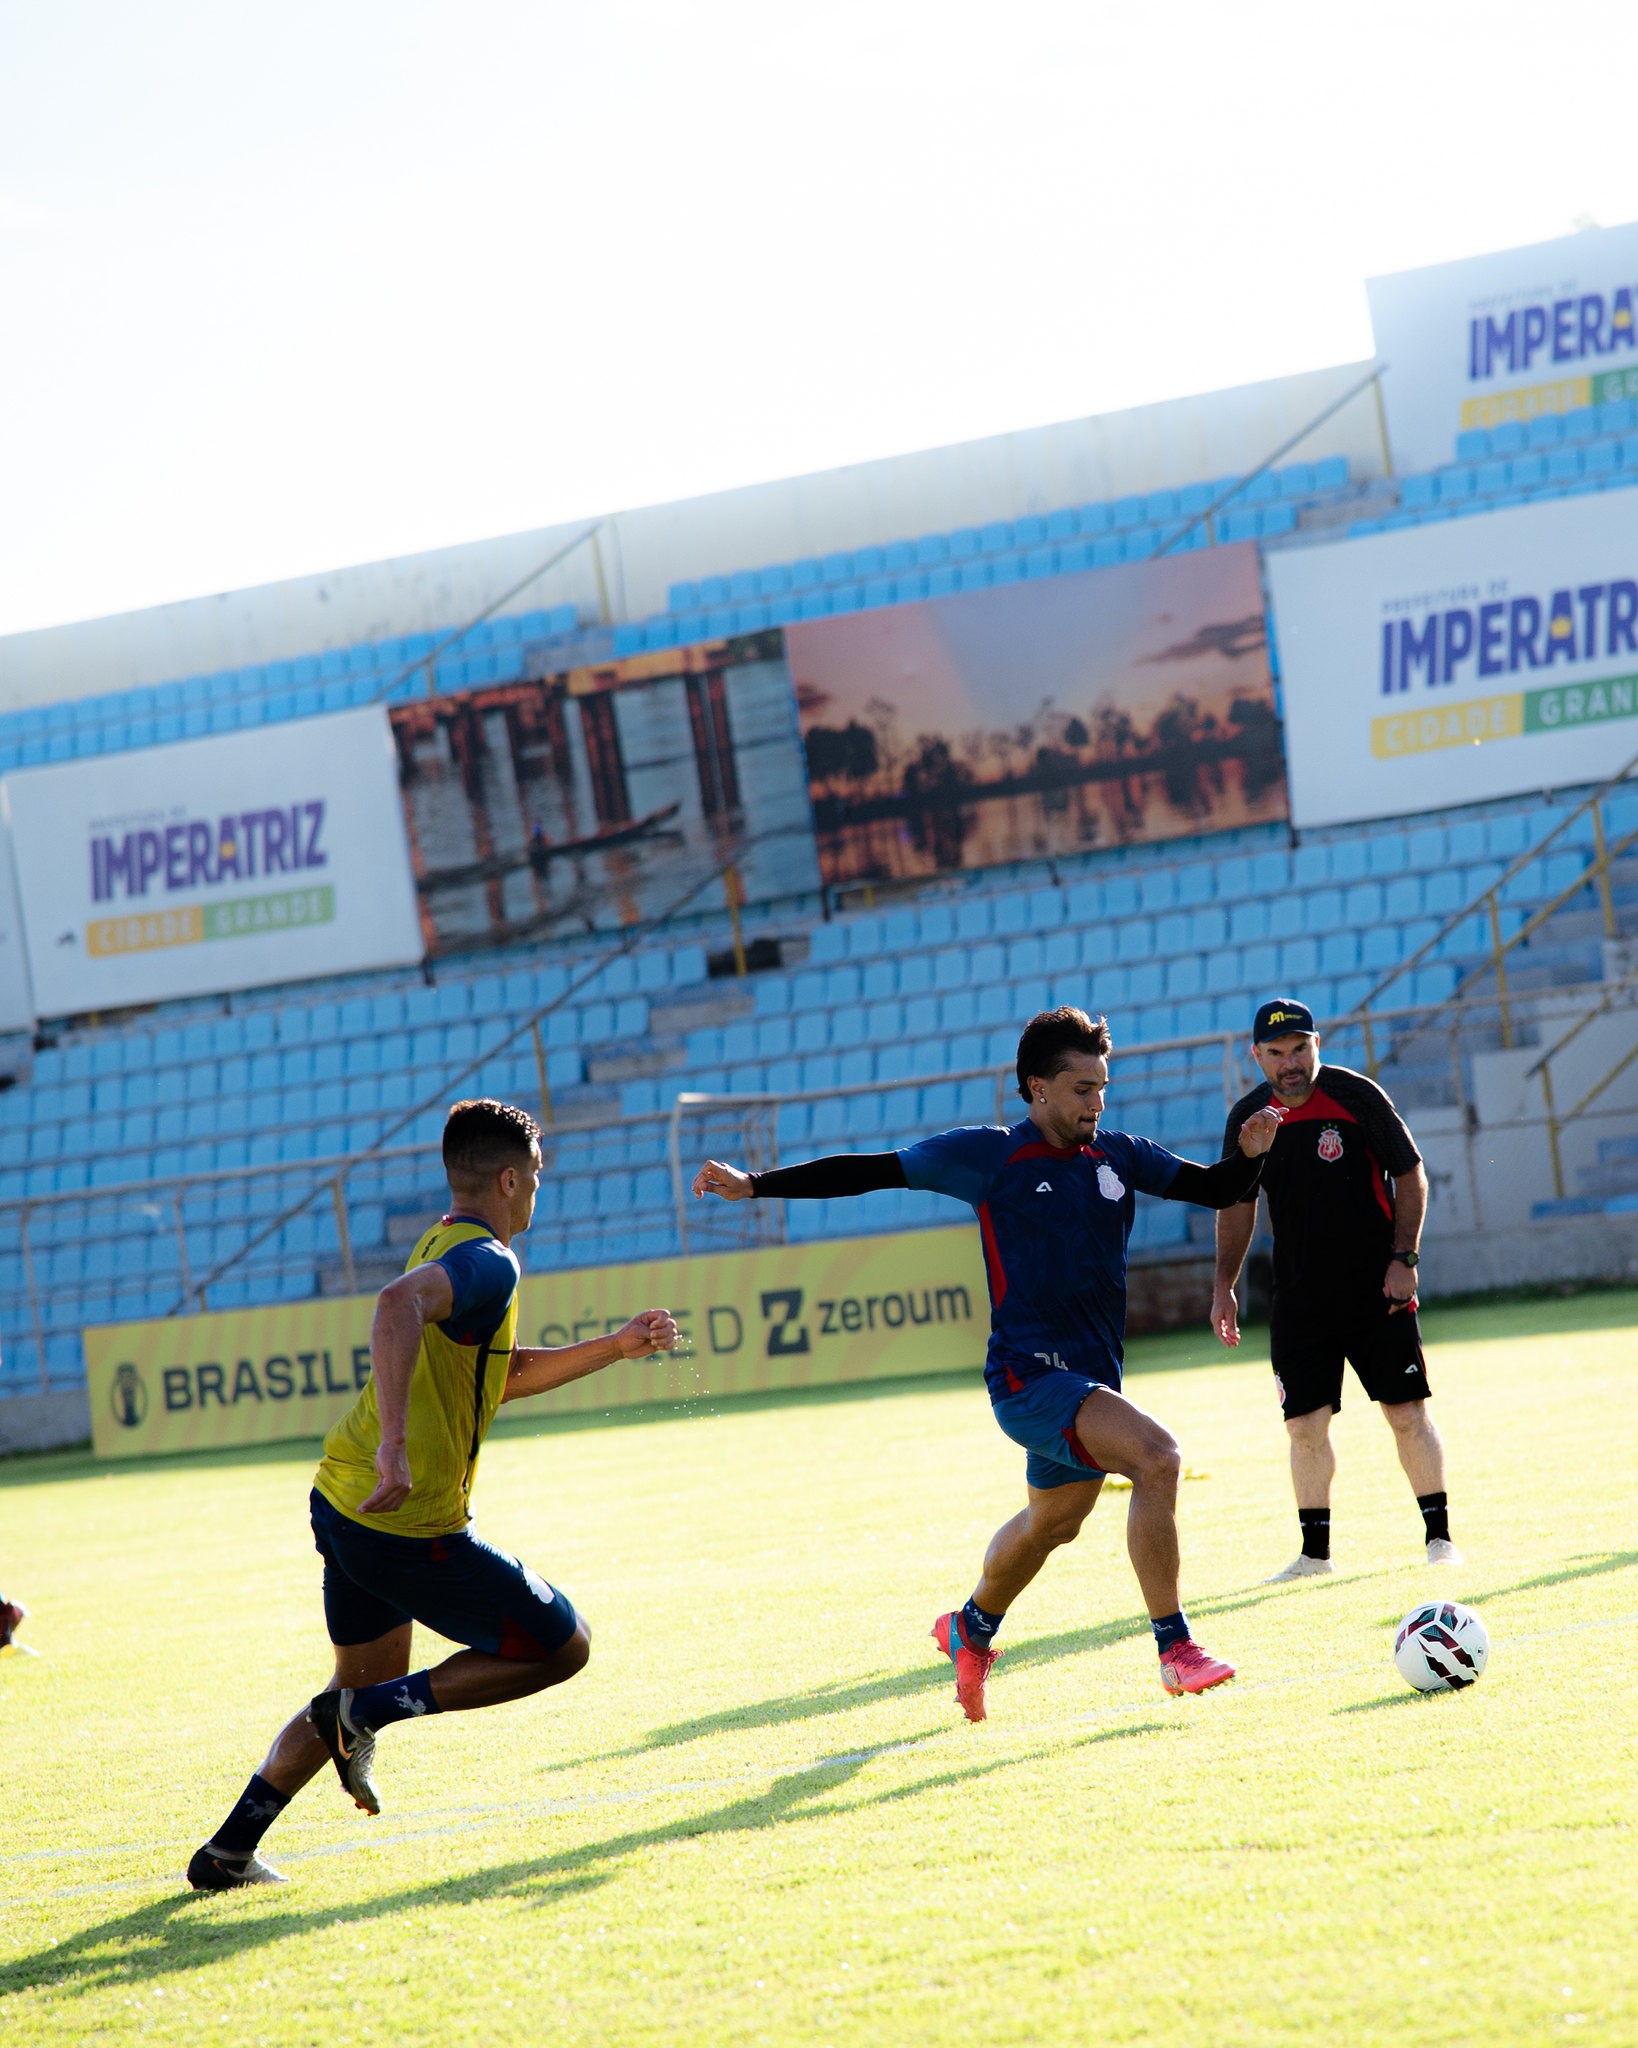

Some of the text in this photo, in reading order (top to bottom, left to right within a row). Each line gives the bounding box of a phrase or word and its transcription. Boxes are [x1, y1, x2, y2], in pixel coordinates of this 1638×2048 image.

[1469, 284, 1638, 381] IMPERA
[1384, 677, 1638, 751] CIDADE GRAN
[90, 800, 328, 902] IMPERATRIZ
[98, 892, 323, 954] CIDADE GRANDE
[708, 1306, 743, 1354] D
[818, 1284, 972, 1335] zeroum
